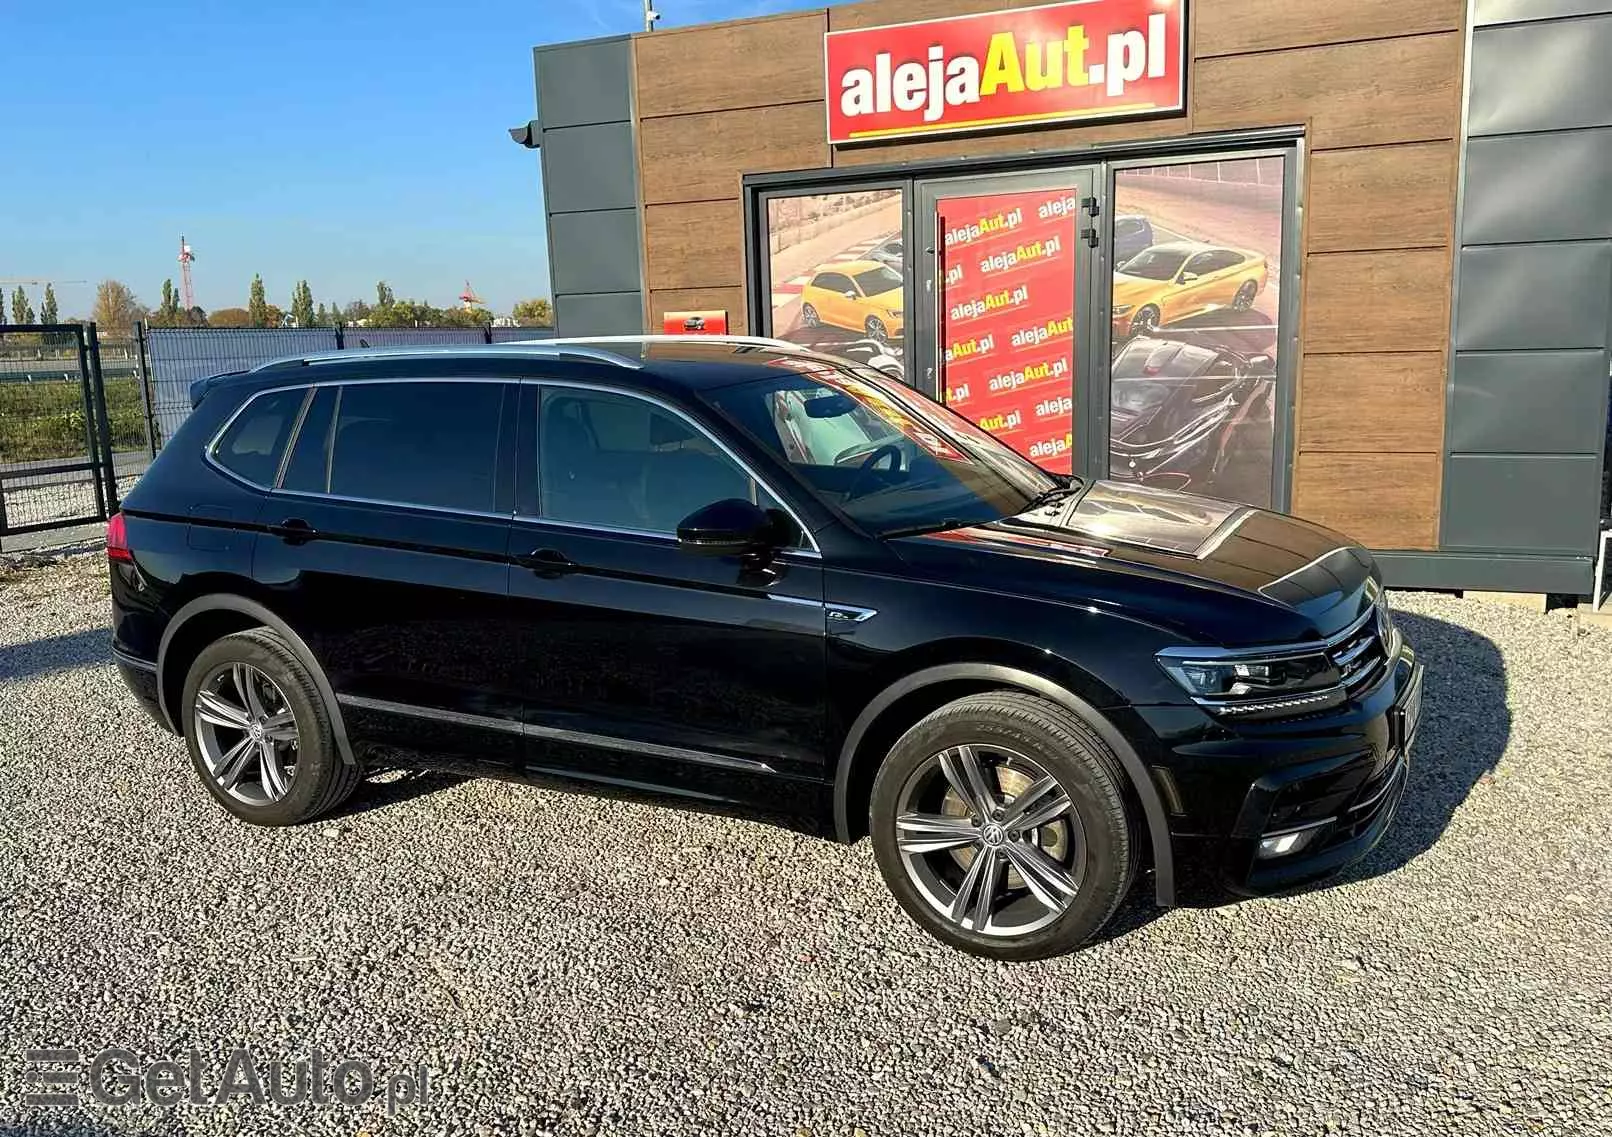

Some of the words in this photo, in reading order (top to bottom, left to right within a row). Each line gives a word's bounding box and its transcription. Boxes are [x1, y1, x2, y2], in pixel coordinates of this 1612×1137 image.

[840, 13, 1167, 122] alejaAut.pl
[1038, 196, 1076, 219] aleja
[944, 207, 1023, 246] alejaAut.pl
[979, 235, 1061, 273] alejaAut.pl
[950, 284, 1029, 321] alejaAut.pl
[988, 356, 1068, 391] alejaAut.pl
[1035, 396, 1073, 417] aleja
